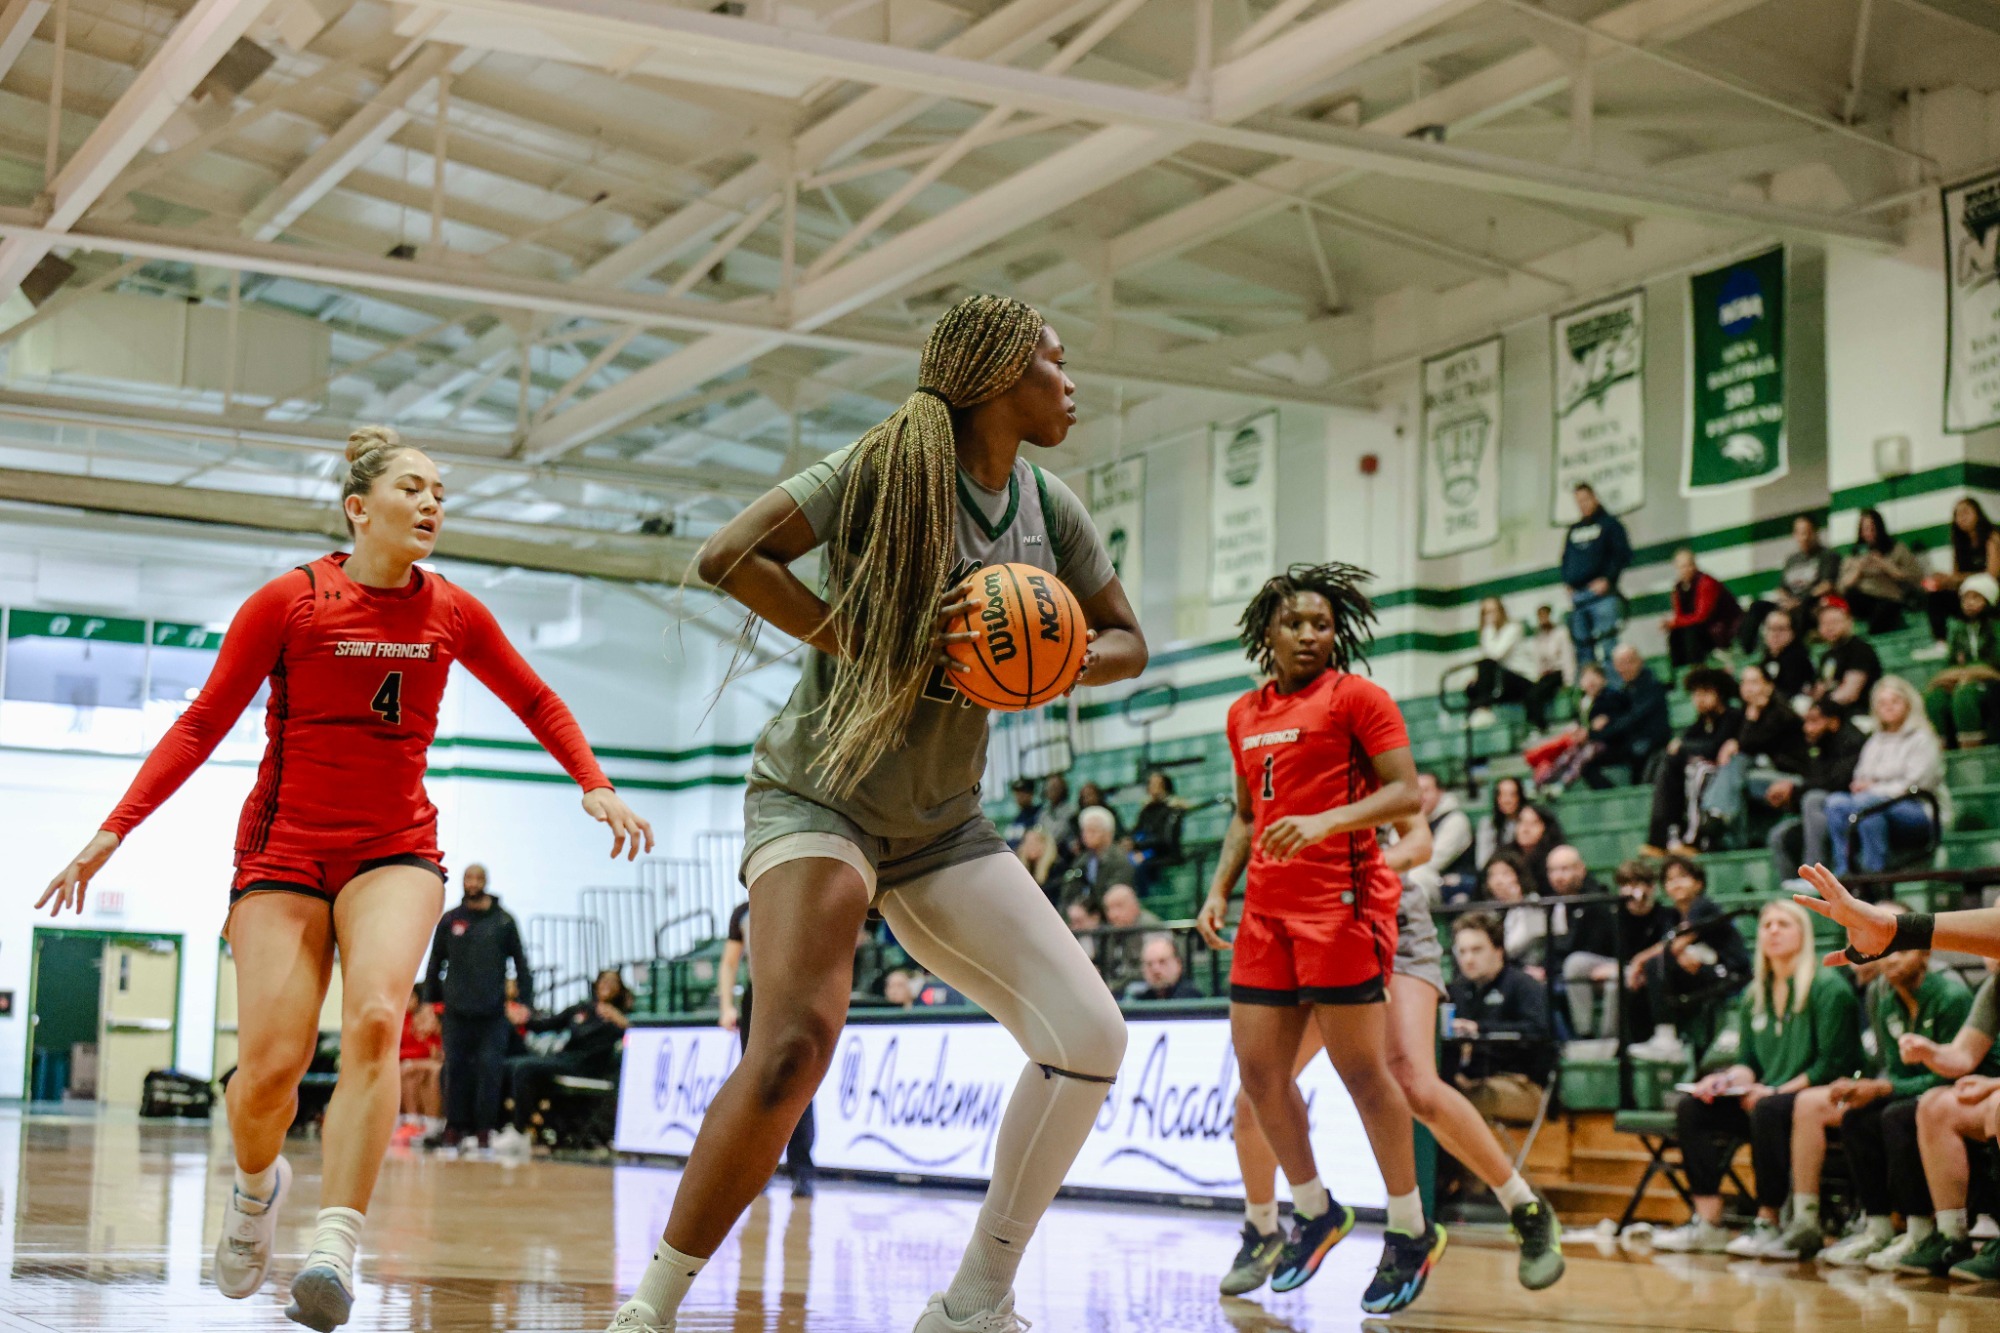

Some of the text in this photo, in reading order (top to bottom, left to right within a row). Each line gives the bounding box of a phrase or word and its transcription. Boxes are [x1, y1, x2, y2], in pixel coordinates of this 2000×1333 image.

[1023, 534, 1042, 544] NEC
[981, 570, 1017, 666] Wilson
[1026, 575, 1061, 644] NCAA
[335, 641, 431, 660] SAINT FRANCIS
[370, 670, 403, 726] 4
[1261, 753, 1275, 801] 1
[866, 1031, 1004, 1171] Academy
